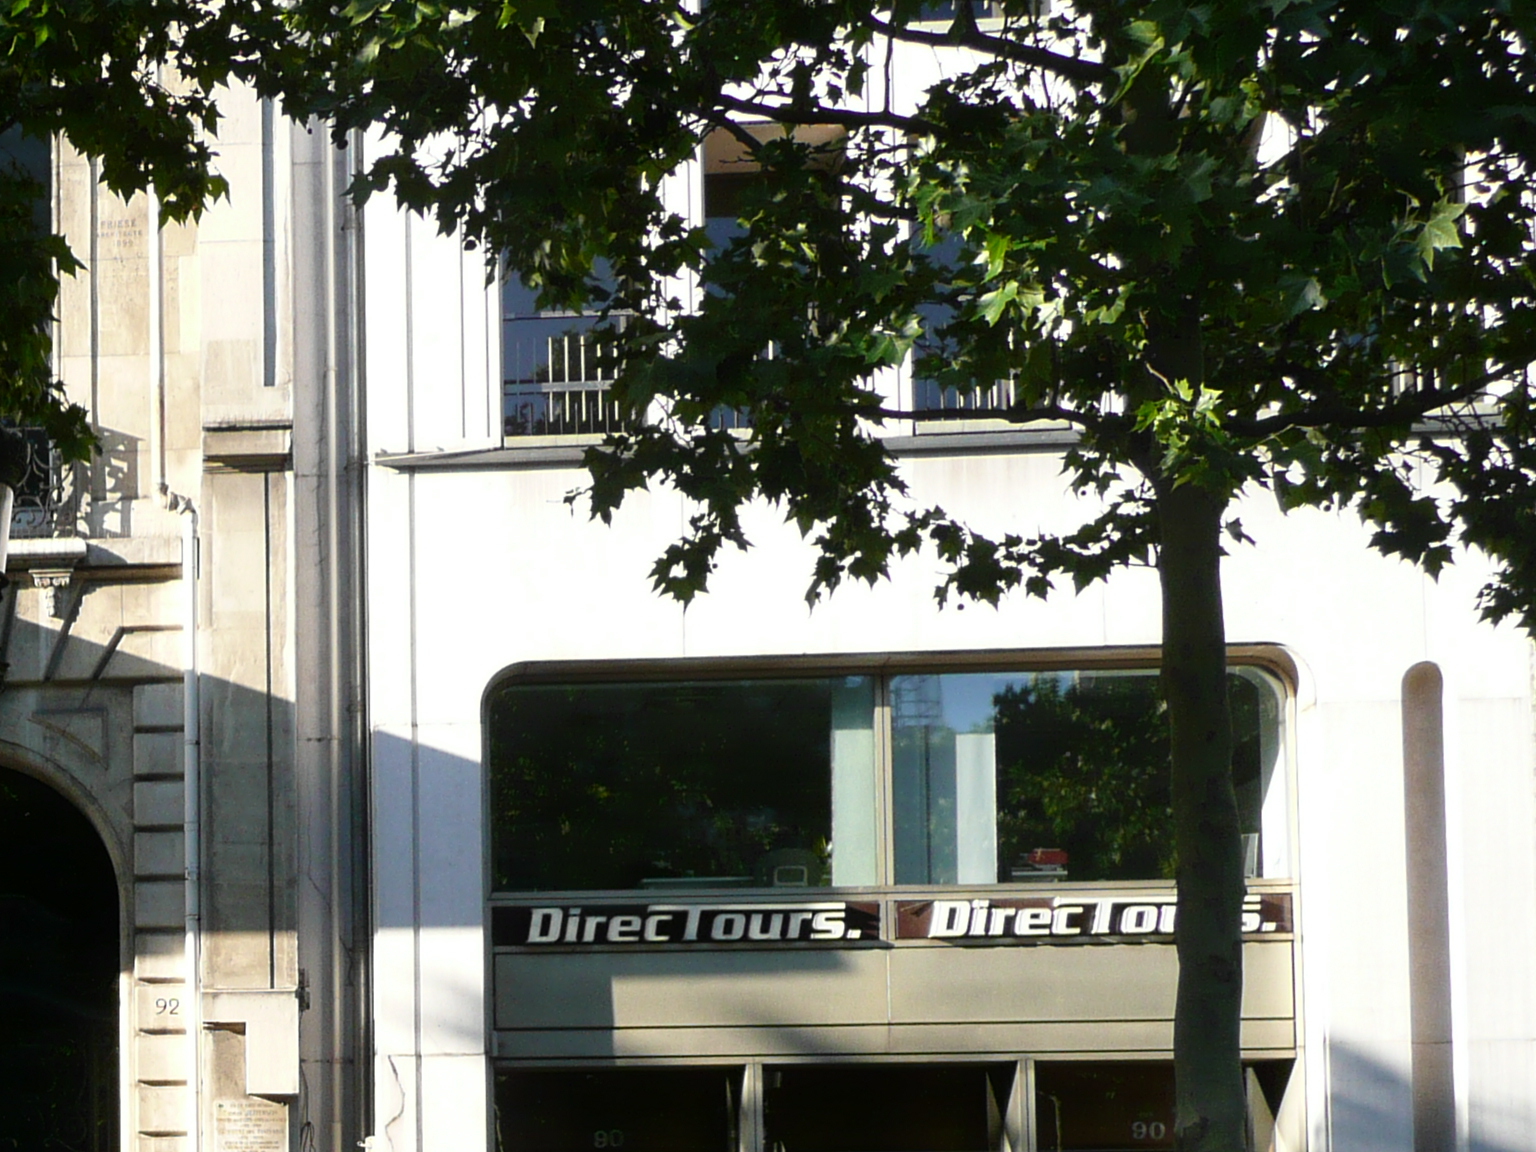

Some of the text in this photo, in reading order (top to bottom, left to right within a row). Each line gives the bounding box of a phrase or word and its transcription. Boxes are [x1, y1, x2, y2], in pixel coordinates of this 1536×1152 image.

[927, 896, 1277, 939] DirecTos.
[155, 998, 180, 1016] 92
[593, 1128, 624, 1149] 90
[1131, 1121, 1166, 1140] 90
